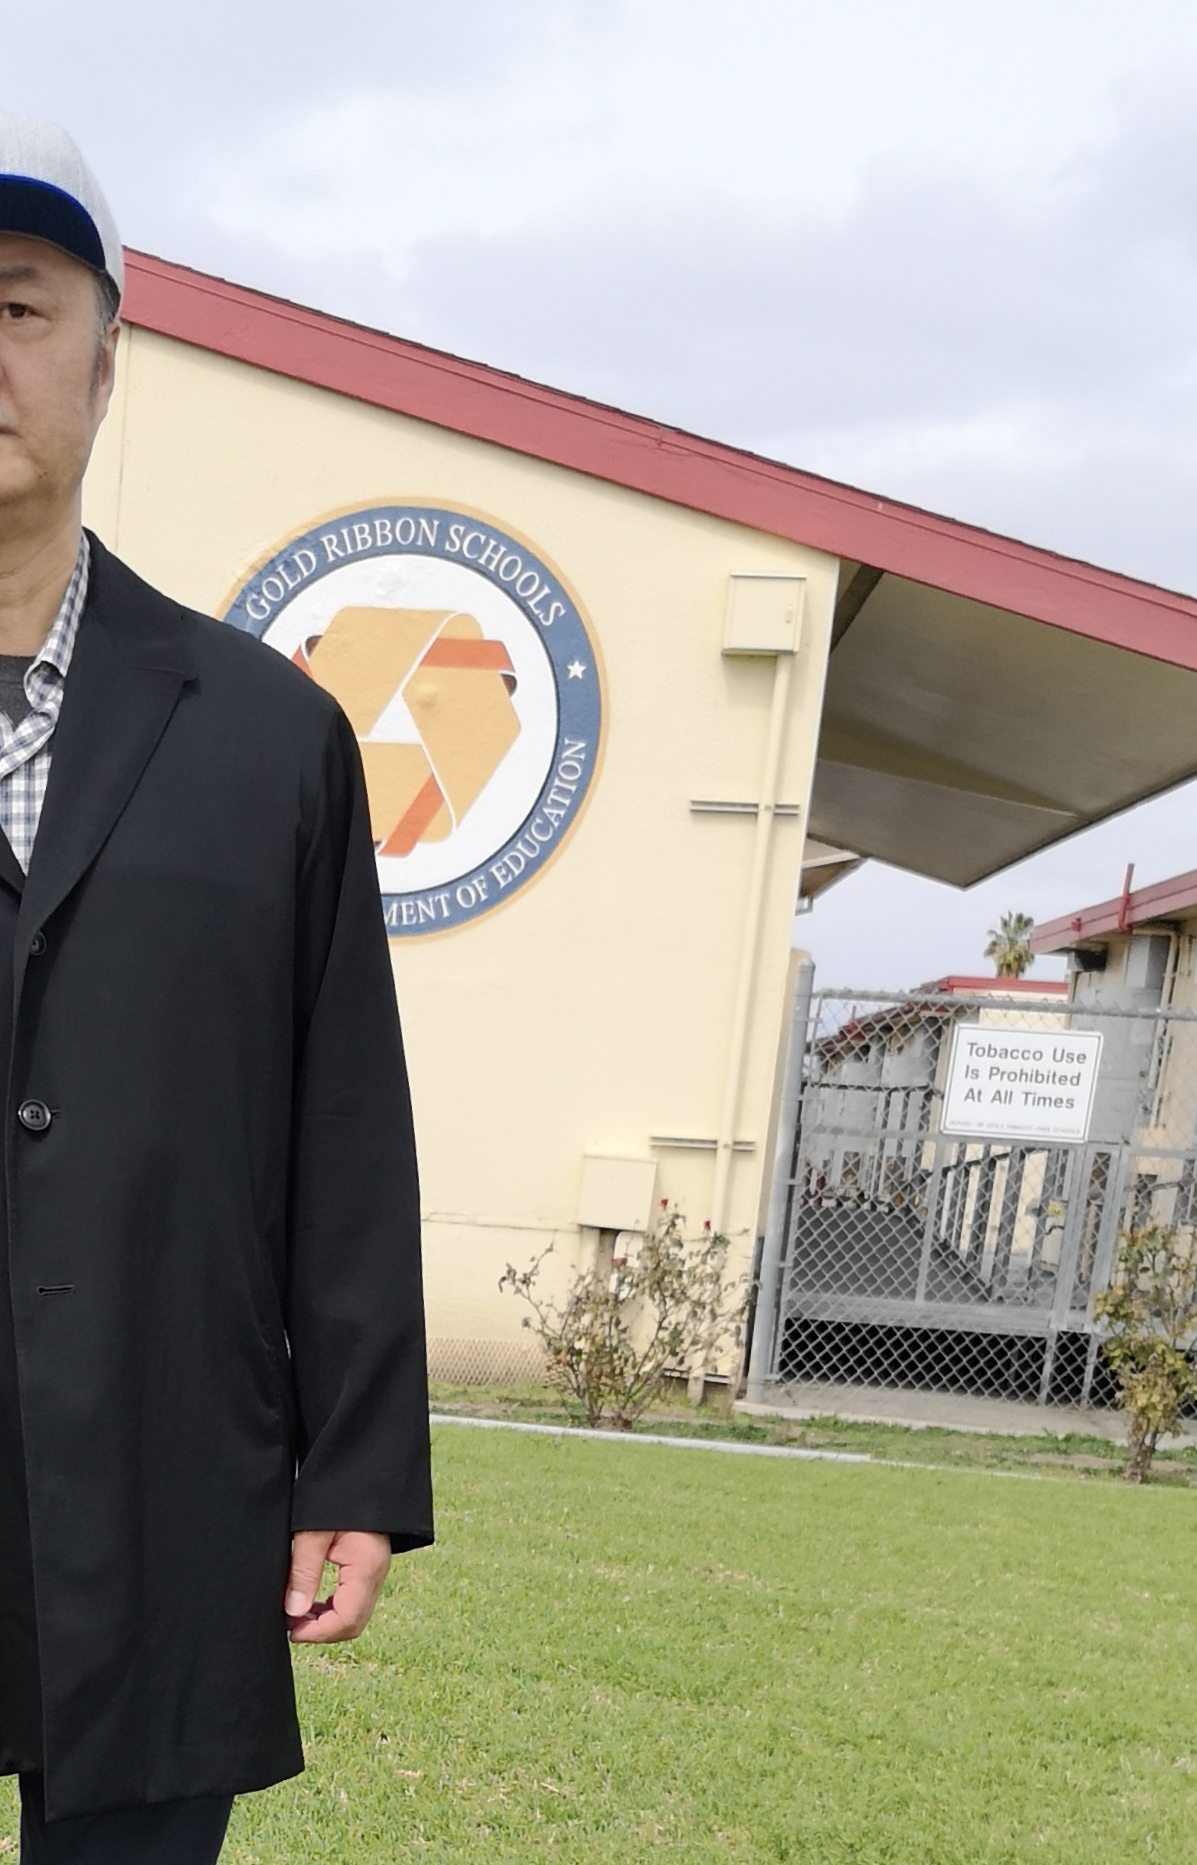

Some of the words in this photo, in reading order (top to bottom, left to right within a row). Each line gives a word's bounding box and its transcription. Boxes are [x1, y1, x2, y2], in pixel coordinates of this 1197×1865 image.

[245, 549, 317, 621] GOLD
[320, 517, 439, 563] RIBBON
[445, 524, 566, 627] SCHOOLS
[456, 875, 488, 908] OF
[489, 739, 586, 889] EDUCATION
[967, 1042, 1043, 1062] Tobacco
[1052, 1048, 1087, 1064] Use
[965, 1065, 979, 1080] Is
[988, 1066, 1081, 1086] Prohibited
[964, 1088, 982, 1103] At
[991, 1089, 1013, 1105] All
[1022, 1091, 1075, 1109] Times
